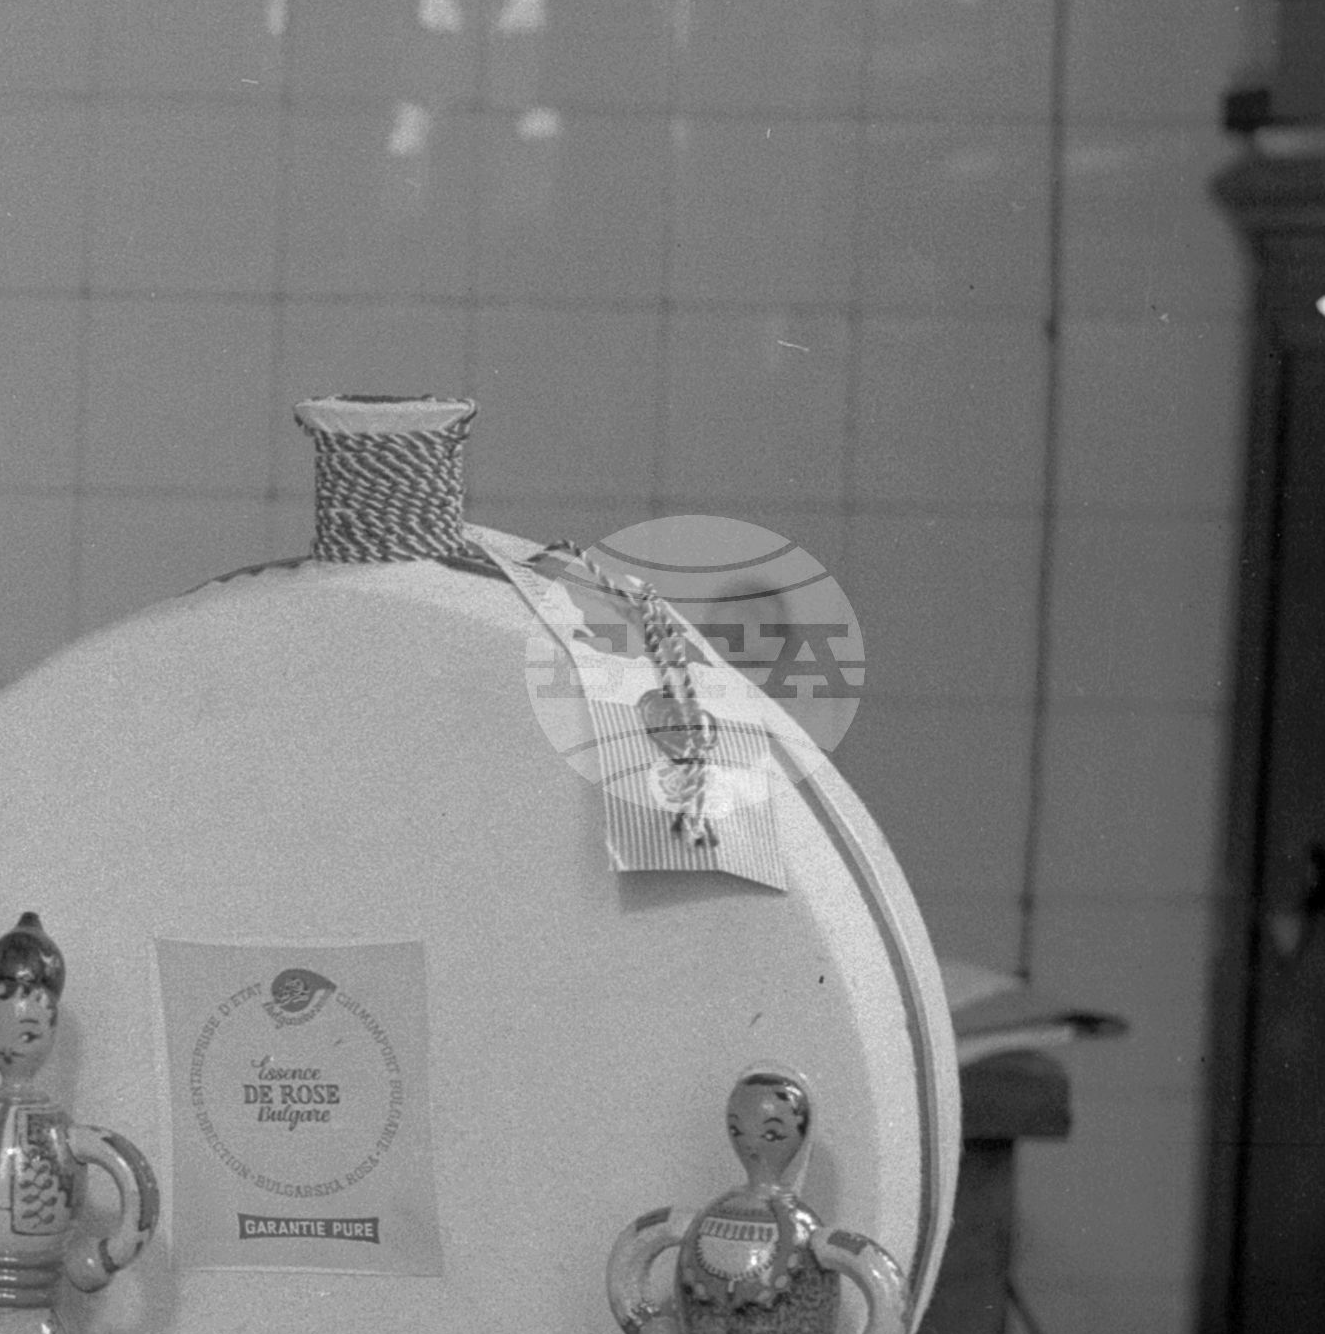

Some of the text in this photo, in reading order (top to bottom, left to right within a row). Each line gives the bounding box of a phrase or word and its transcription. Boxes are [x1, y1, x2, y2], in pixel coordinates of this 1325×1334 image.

[250, 1055, 322, 1081] Essence
[243, 1084, 341, 1105] DE ROSE
[257, 1103, 332, 1132] Bulgare
[245, 1219, 375, 1238] GARANTIE PURE
